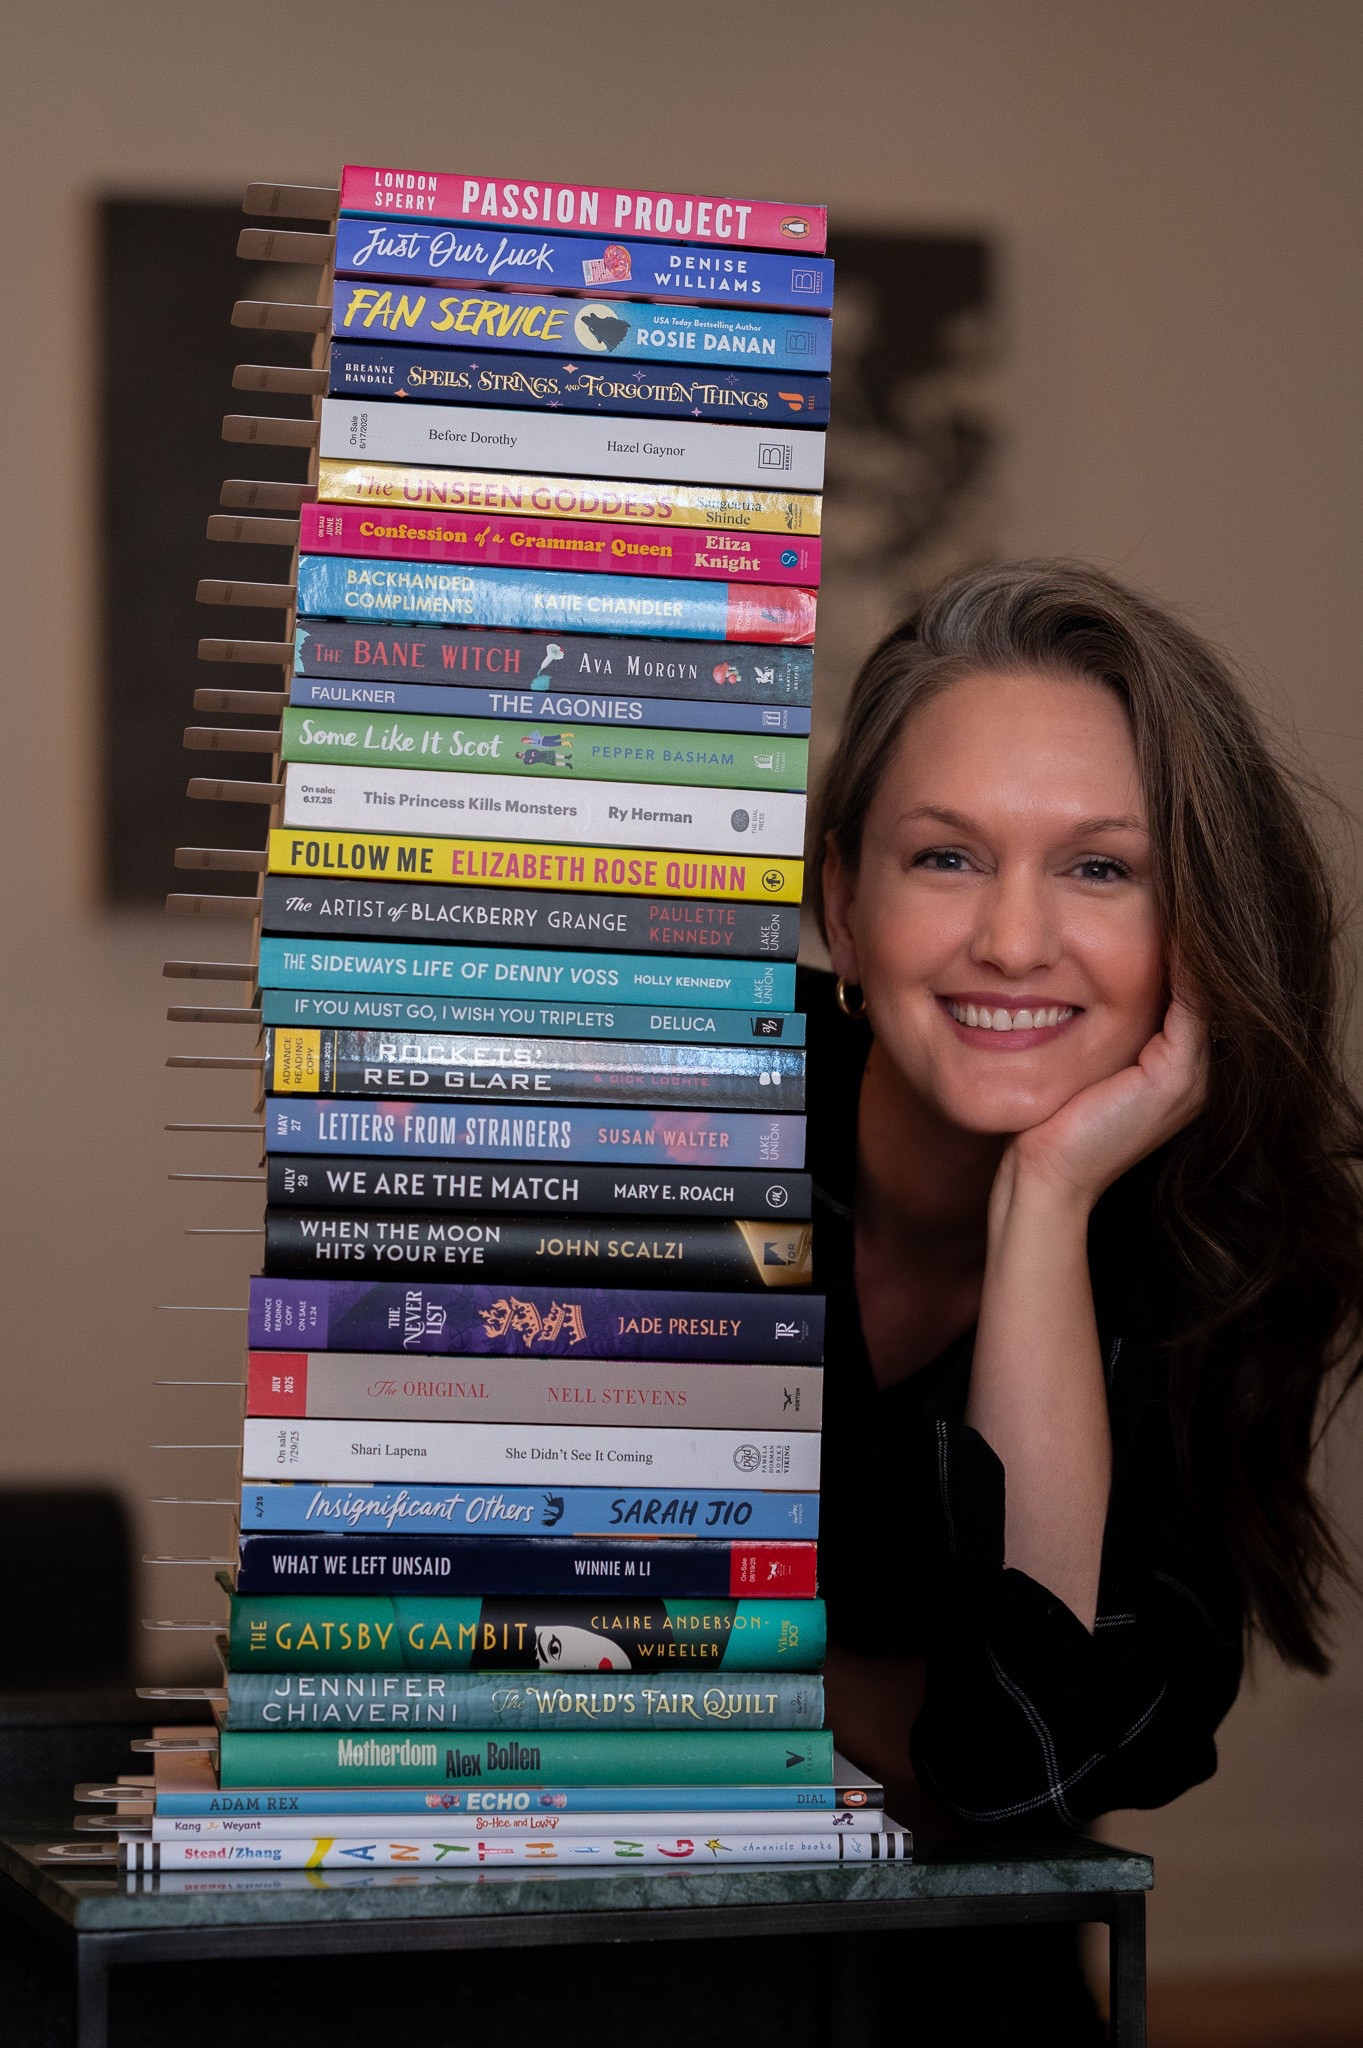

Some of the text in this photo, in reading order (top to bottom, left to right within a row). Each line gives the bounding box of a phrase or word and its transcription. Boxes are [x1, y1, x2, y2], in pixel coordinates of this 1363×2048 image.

[374, 171, 437, 192] LONDON
[374, 191, 436, 211] SPERRY
[461, 180, 752, 240] PASSION PROJECT
[669, 255, 748, 274] DENISE
[654, 272, 762, 293] WILLIAMS
[342, 288, 569, 341] FAN SERVICE
[653, 316, 762, 332] USA Today Bestselling Author
[636, 328, 776, 355] ROSIE DANAN
[345, 363, 396, 375] BREANNE
[345, 373, 394, 385] RANDALL
[350, 415, 358, 445] On Sale
[359, 413, 368, 449] 6/17/2025
[429, 429, 518, 447] Before Dorothy
[606, 440, 686, 458] Hazel Gaynor
[403, 478, 522, 508] UNSEEN
[531, 487, 673, 519] GODDESS
[335, 517, 343, 536] 2025
[706, 511, 751, 525] Shinde
[705, 535, 752, 552] Eliza
[694, 552, 761, 573] Knight
[347, 569, 475, 592] BACKHANDED
[344, 591, 474, 615] COMPLIMENTS
[534, 592, 683, 617] KATIE CHANDLER
[311, 686, 643, 720] FAULKNER THE AGONIES
[592, 745, 734, 766] PEPPER BASHAM
[301, 785, 336, 795] On sale:
[303, 795, 333, 805] 6.17.25
[608, 805, 693, 824] Ry Herman
[290, 840, 746, 892] FOLLOW ME ELIZABETH ROSE QUINN
[649, 905, 736, 925] PAULETTE
[649, 927, 734, 946] KENNEDY
[760, 925, 770, 950] LAKE
[770, 914, 780, 951] UNION
[633, 974, 732, 989] HOLLY KENNEDY
[294, 998, 614, 1027] IF YOU MUST GO, I WISH YOU TRIPLETS
[650, 1015, 716, 1032] DELUCA
[282, 1036, 292, 1085] ADVANCE
[294, 1037, 304, 1084] READING
[306, 1047, 314, 1075] COPY
[364, 1068, 552, 1091] RED GLARE
[277, 1113, 288, 1136] MAY
[291, 1119, 301, 1131] 27
[598, 1128, 730, 1148] SUSAN WALTER
[284, 1168, 296, 1193] JULY
[298, 1174, 309, 1187] 29
[614, 1183, 734, 1202] MARY E. ROACH
[535, 1238, 683, 1260] JOHN SCALZI
[264, 1297, 272, 1333] ADVANCE
[298, 1300, 307, 1331] ON SALE
[388, 1307, 401, 1329] THE
[403, 1290, 425, 1350] NEVER
[425, 1302, 447, 1335] LIST
[618, 1316, 742, 1337] JADE PRESLEY
[271, 1376, 281, 1393] JULY
[285, 1376, 294, 1394] 2025
[367, 1380, 489, 1399] The ORIGINAL
[547, 1387, 688, 1407] NELL STEVENS
[277, 1430, 287, 1464] On sale
[290, 1430, 300, 1464] 7/29/25
[351, 1443, 427, 1459] Shari Lapena
[505, 1447, 653, 1465] She Didn't See It Coming
[256, 1495, 264, 1519] 4/25
[305, 1489, 536, 1529] Insignificant Others
[609, 1498, 753, 1526] SARAH JIO
[574, 1560, 650, 1576] WINNIE M LI
[590, 1615, 770, 1630] CLAIRE ANDERSON-
[250, 1621, 528, 1651] THE GATSBY GAMBIT
[778, 1619, 791, 1653] Viking
[789, 1625, 799, 1647] 100
[637, 1643, 718, 1657] WHEELER
[274, 1678, 446, 1698] JENNIFER
[262, 1702, 457, 1723] CHIAVERINI
[337, 1738, 541, 1779] Motherdom Alex Bollen
[209, 1797, 299, 1811] ADAM REX
[466, 1792, 530, 1811] ECHO
[797, 1794, 826, 1804] DIAL
[175, 1820, 262, 1833] Kang Weyant
[475, 1816, 559, 1830] So-Hee and Lowy
[184, 1846, 282, 1861] Stead/Zhang
[742, 1841, 832, 1852] chronicle books
